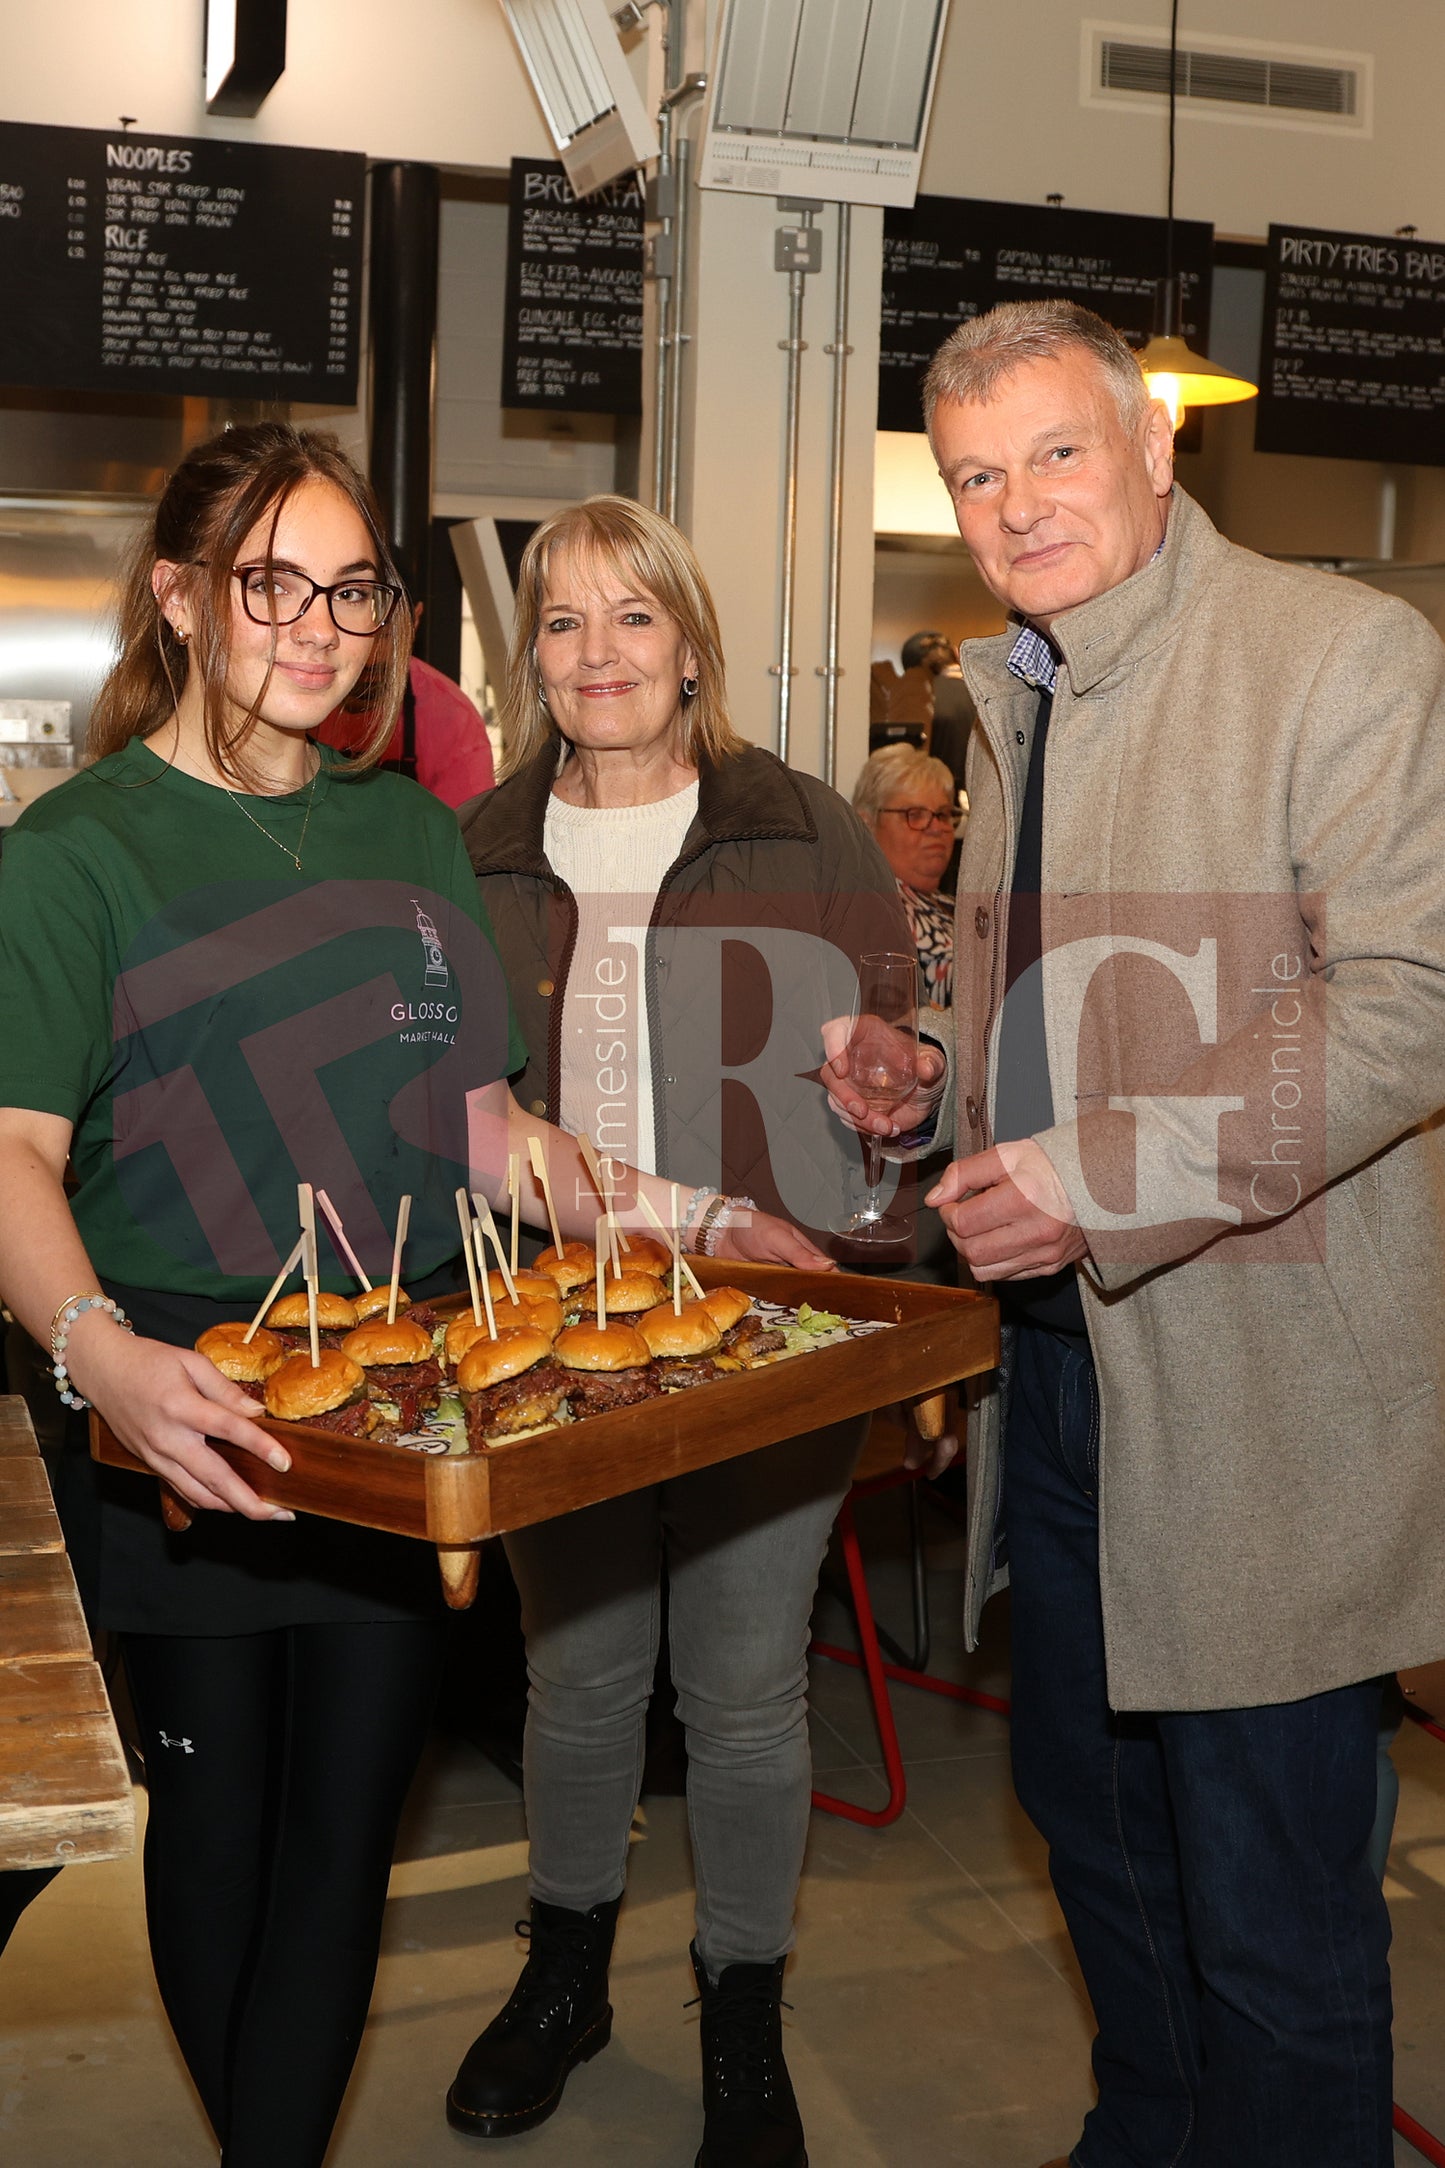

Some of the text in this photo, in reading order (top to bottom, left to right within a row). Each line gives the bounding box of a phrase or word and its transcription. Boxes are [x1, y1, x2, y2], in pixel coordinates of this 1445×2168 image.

[106, 144, 193, 173] NOODLES
[106, 177, 142, 193] VEGAN
[148, 181, 172, 195] STIR
[175, 184, 211, 198] FRIED
[216, 187, 245, 201] UDON
[105, 194, 127, 207] STIR
[131, 195, 161, 210] FRIED
[164, 198, 190, 212] UDON
[195, 200, 239, 215] CHICKEN
[105, 208, 127, 221] STIR
[130, 209, 160, 224] FRIED
[164, 212, 190, 226] UDON
[195, 214, 233, 228] PRAWN
[523, 208, 581, 227] SAUSAGE
[596, 214, 640, 230] BACON
[104, 225, 149, 250] RICE
[104, 250, 143, 265] STEAMED
[146, 251, 168, 266] RICE
[997, 249, 1042, 266] CAPTAIN
[1280, 237, 1341, 268] DIRTY
[1343, 244, 1399, 275] FRIES
[183, 271, 211, 285] FRIED
[215, 272, 238, 286] RICE
[547, 264, 581, 282] FETA
[193, 286, 227, 300] FRIED
[227, 287, 250, 301] RICE
[164, 297, 198, 311] CHICKEN
[145, 311, 172, 324] FRIED
[174, 312, 196, 326] RICE
[253, 330, 273, 344] RICE
[161, 340, 182, 353] RICE
[200, 356, 223, 370] RICE
[543, 369, 577, 384] RANGE
[400, 1031, 456, 1045] MARKET HALL
